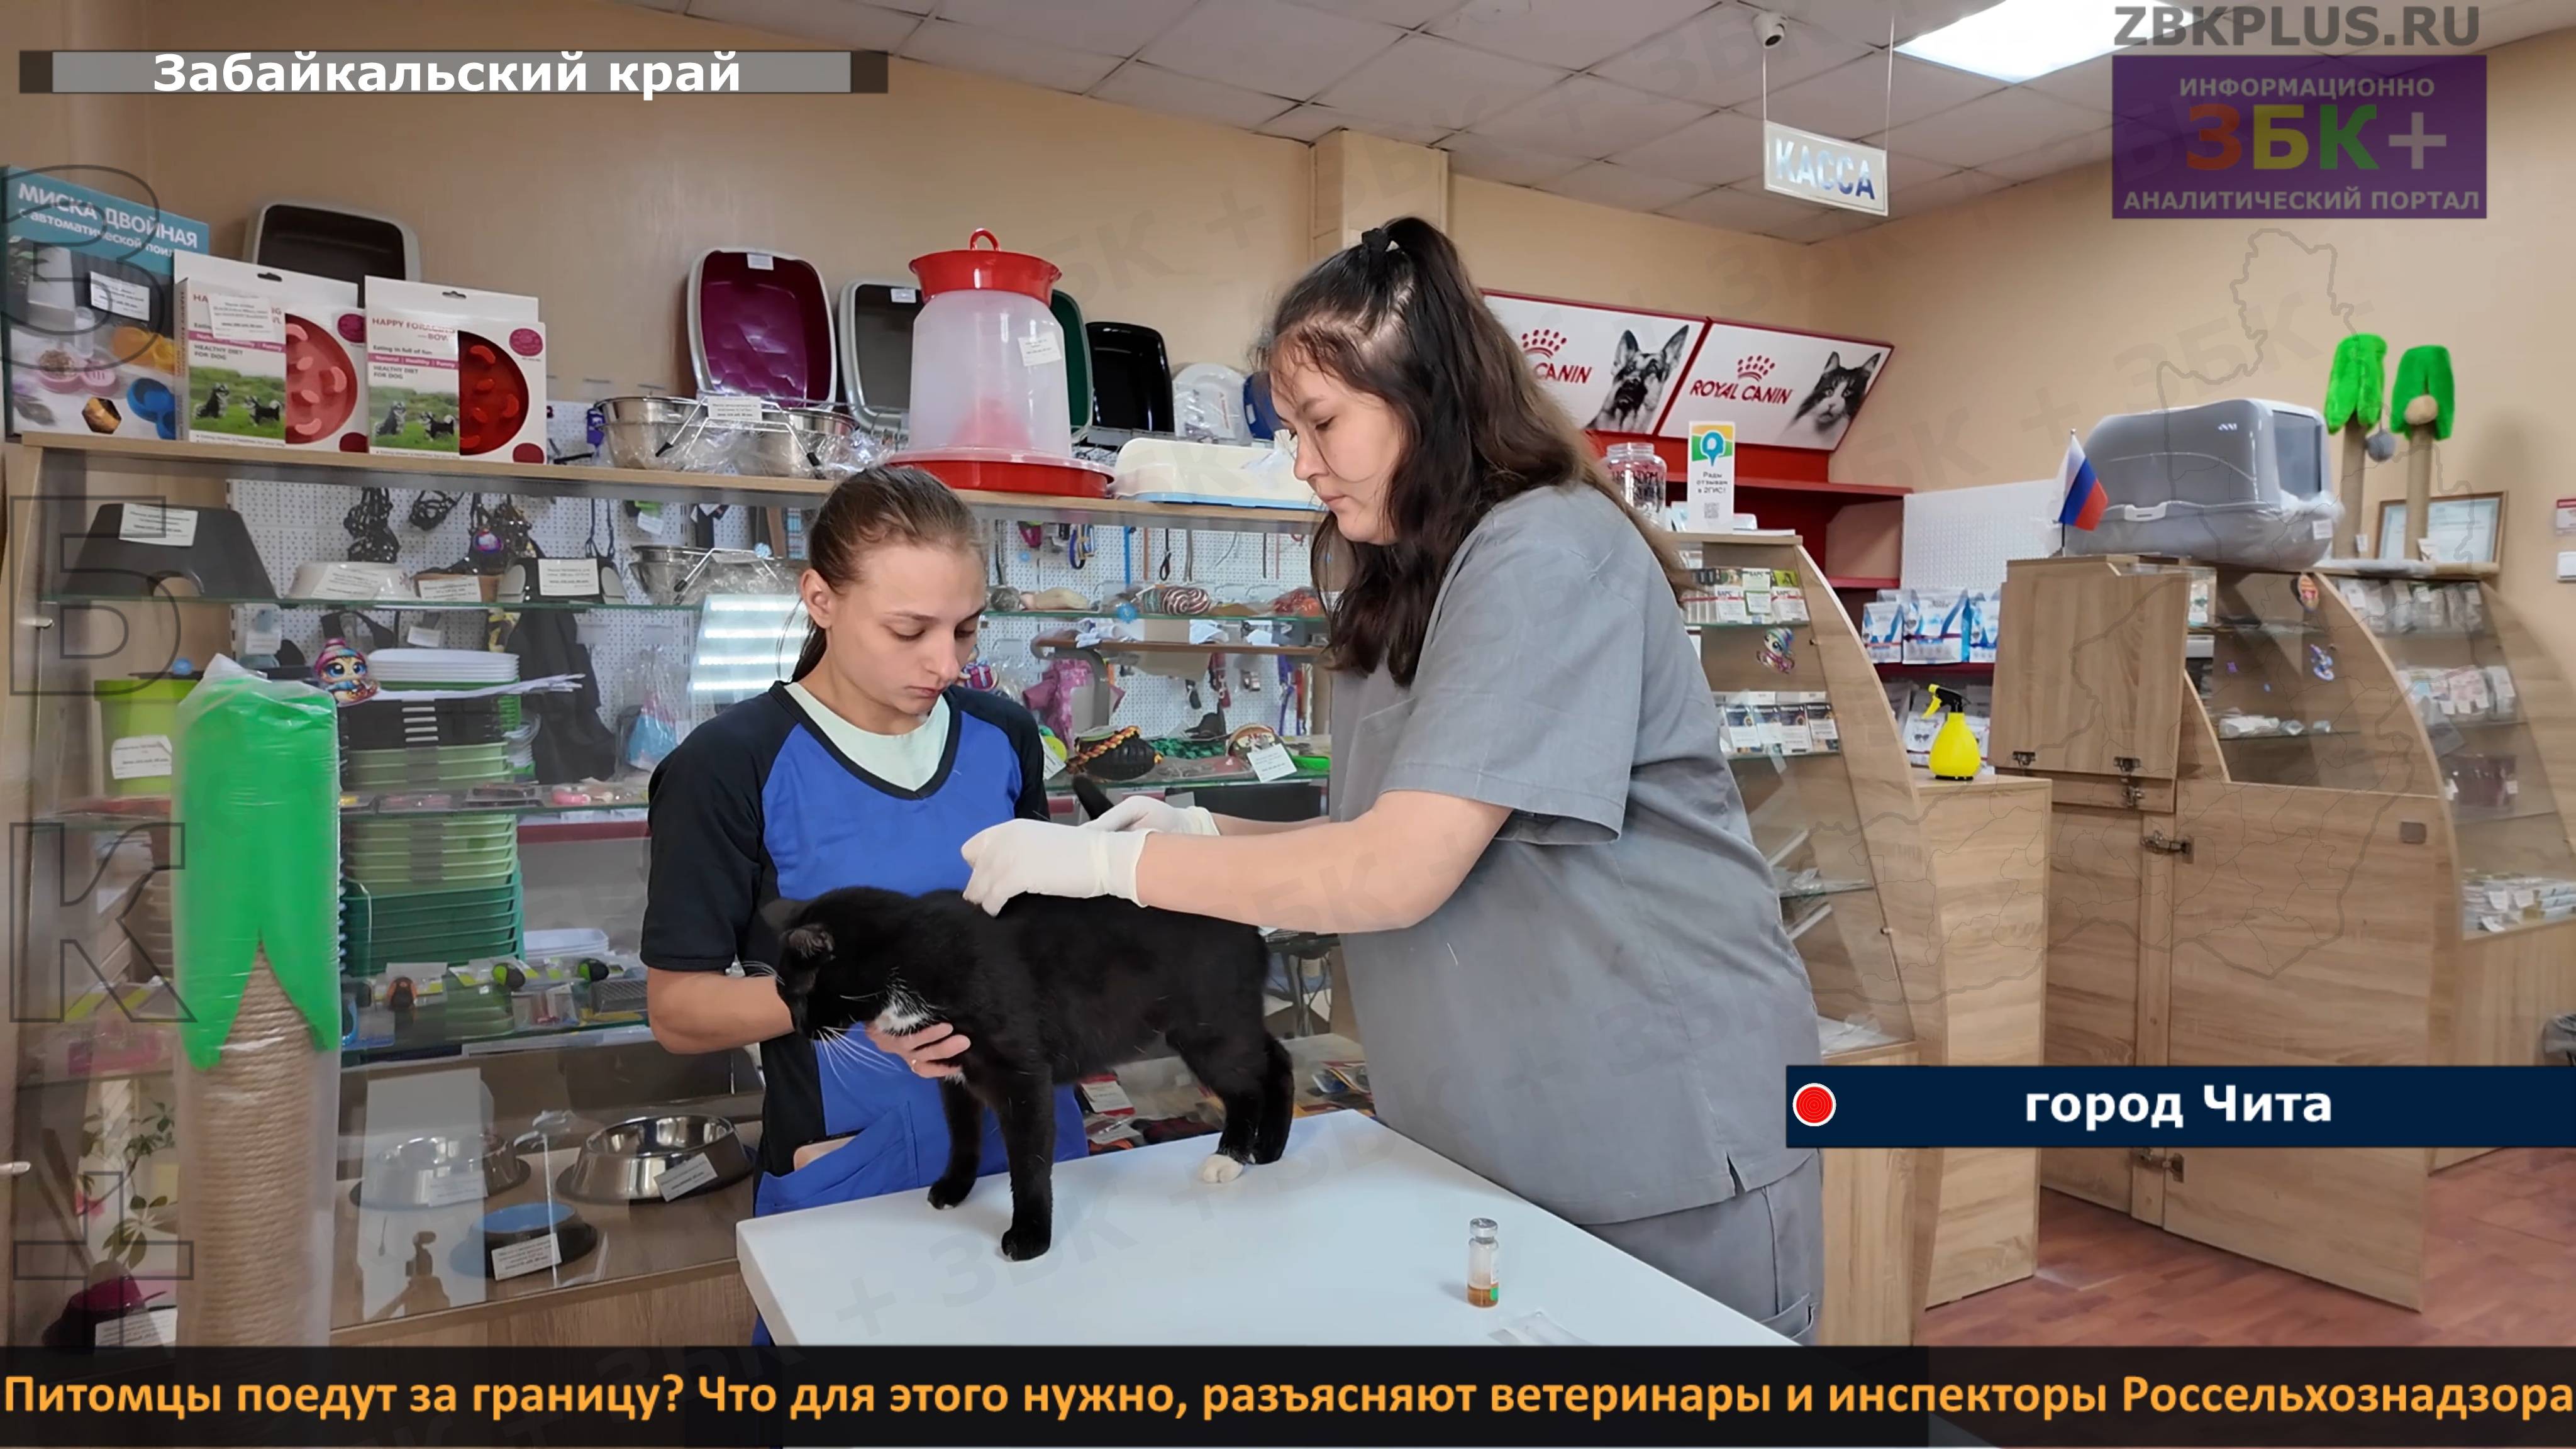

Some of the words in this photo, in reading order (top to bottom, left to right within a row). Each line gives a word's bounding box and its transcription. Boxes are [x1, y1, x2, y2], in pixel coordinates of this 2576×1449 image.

[1775, 138, 1875, 200] КАССА
[18, 182, 98, 220] МИСКА
[104, 206, 197, 250] ДВОЙНАЯ
[31, 211, 143, 248] автоматической
[372, 317, 404, 328] HAPPY
[1535, 362, 1592, 384] CANIN
[1690, 379, 1739, 399] ROYAL
[1741, 385, 1793, 404] CANIN
